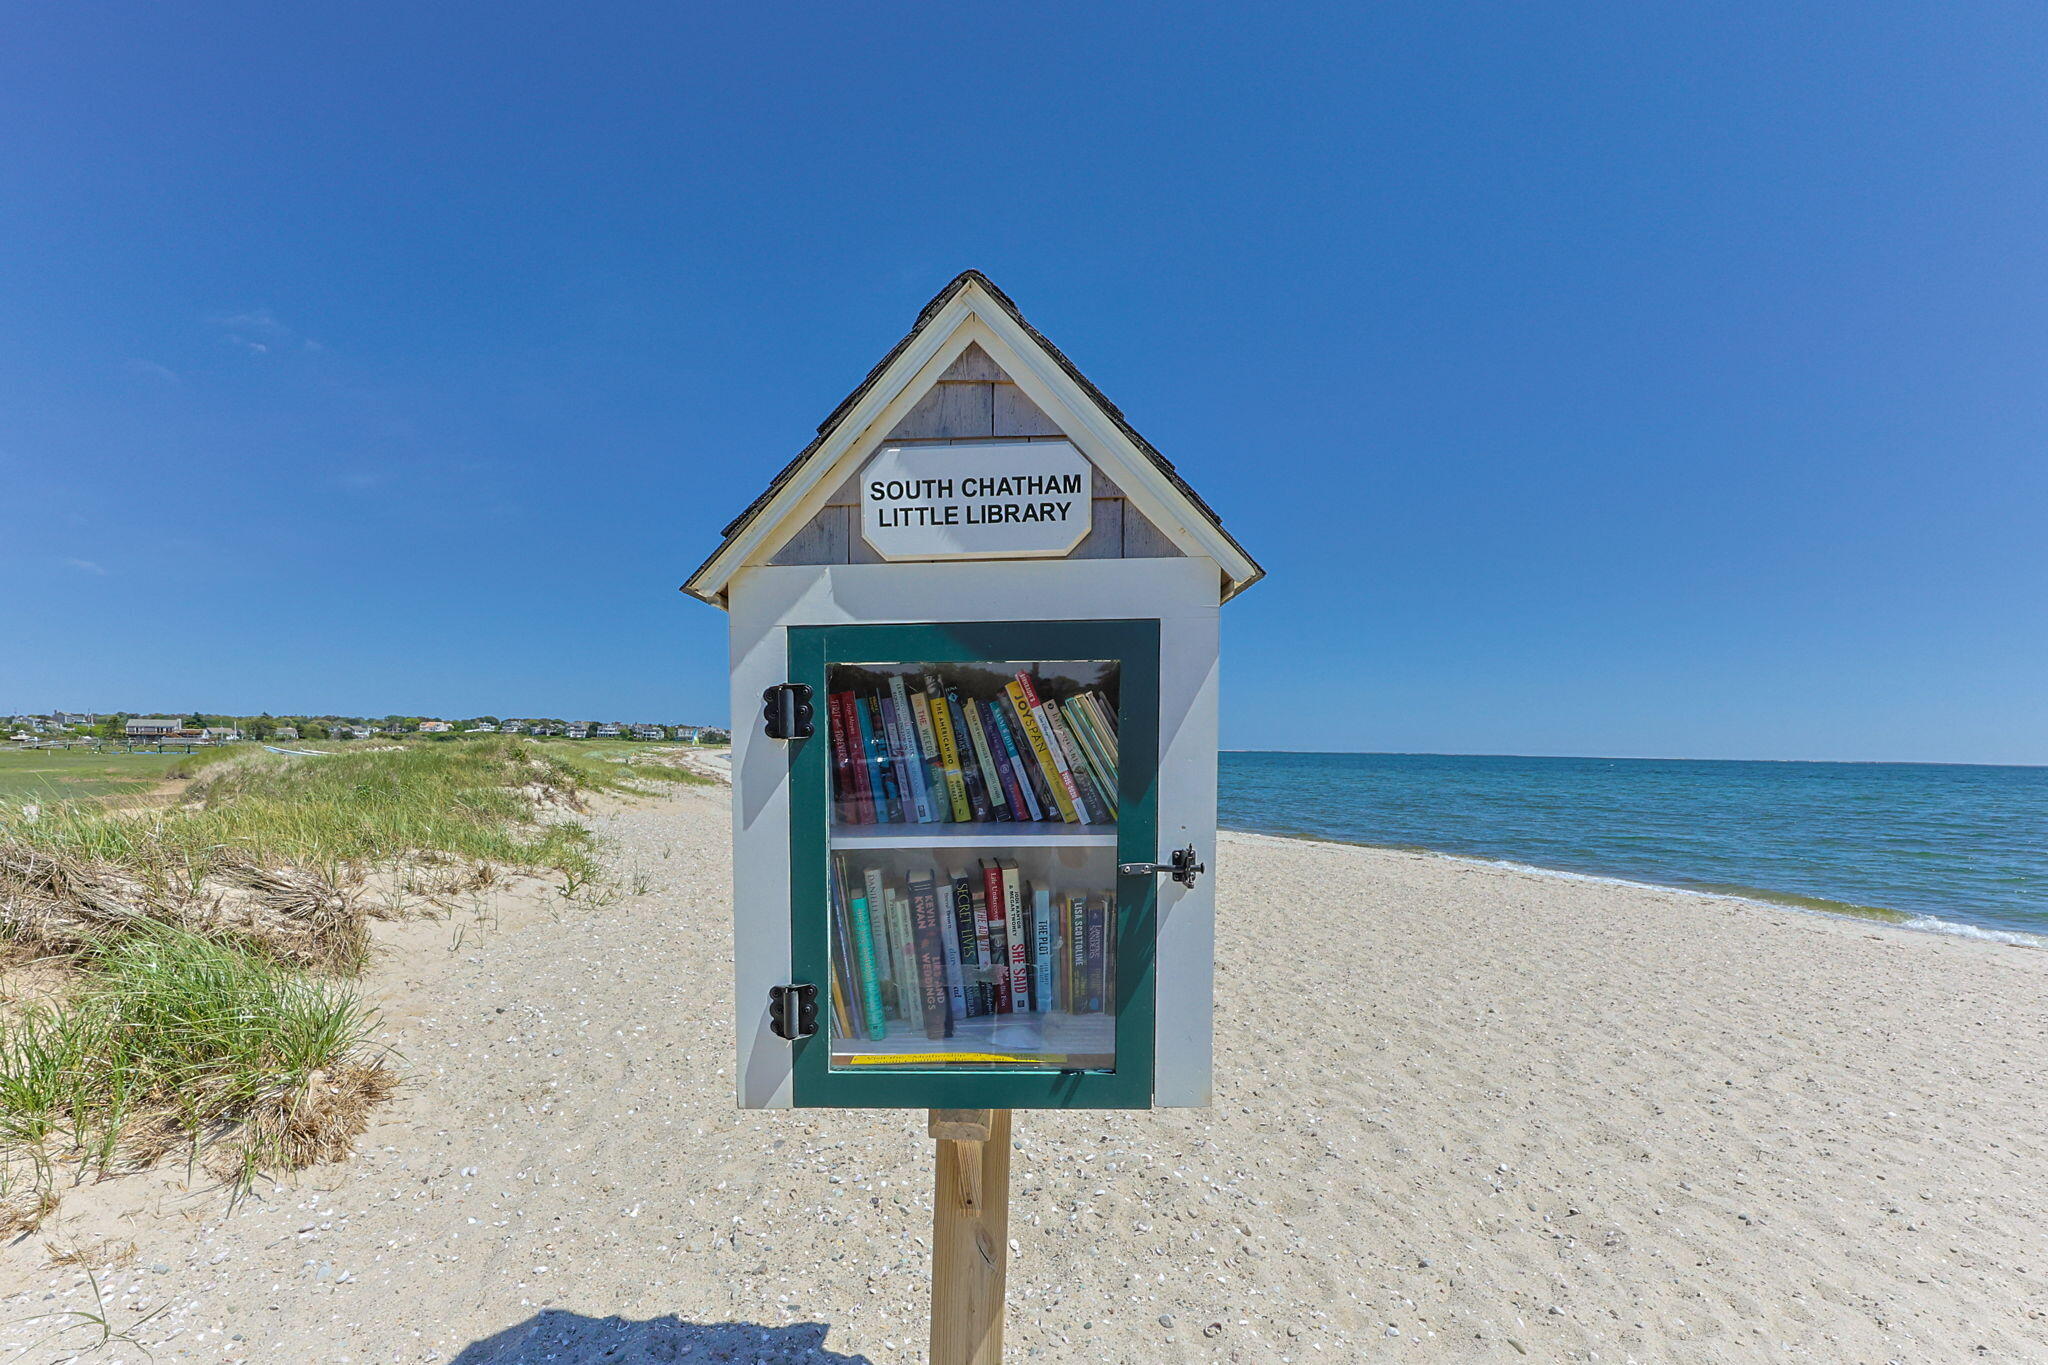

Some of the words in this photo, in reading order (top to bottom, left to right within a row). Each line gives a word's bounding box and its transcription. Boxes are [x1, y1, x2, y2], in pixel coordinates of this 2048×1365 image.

[870, 479, 952, 501] SOUTH
[961, 474, 1081, 498] CHATHAM
[879, 506, 958, 527] LITTLE
[966, 502, 1072, 525] LIBRARY
[916, 709, 928, 726] THE
[935, 702, 943, 714] THE
[938, 716, 950, 750] AMERICAN
[1014, 694, 1046, 752] JOYSPAN
[921, 727, 936, 756] WEEDS
[945, 750, 954, 764] NO
[954, 779, 964, 800] RUPERT
[914, 895, 926, 928] KWAN
[924, 894, 936, 927] KEVIN
[955, 882, 972, 924] SECRET
[991, 885, 1000, 920] Undercover
[1074, 902, 1082, 918] LISA
[976, 910, 986, 923] THE
[1038, 920, 1047, 934] THE
[961, 928, 976, 957] LIVES
[978, 924, 990, 952] ADLTS
[1038, 936, 1048, 955] PLOT
[1074, 920, 1083, 966] SCOTTOLINE
[931, 955, 942, 977] LIES
[1011, 943, 1025, 964] SHE
[921, 952, 936, 1010] WEDDINGS
[934, 980, 944, 1003] AND
[1013, 967, 1028, 993] SAID
